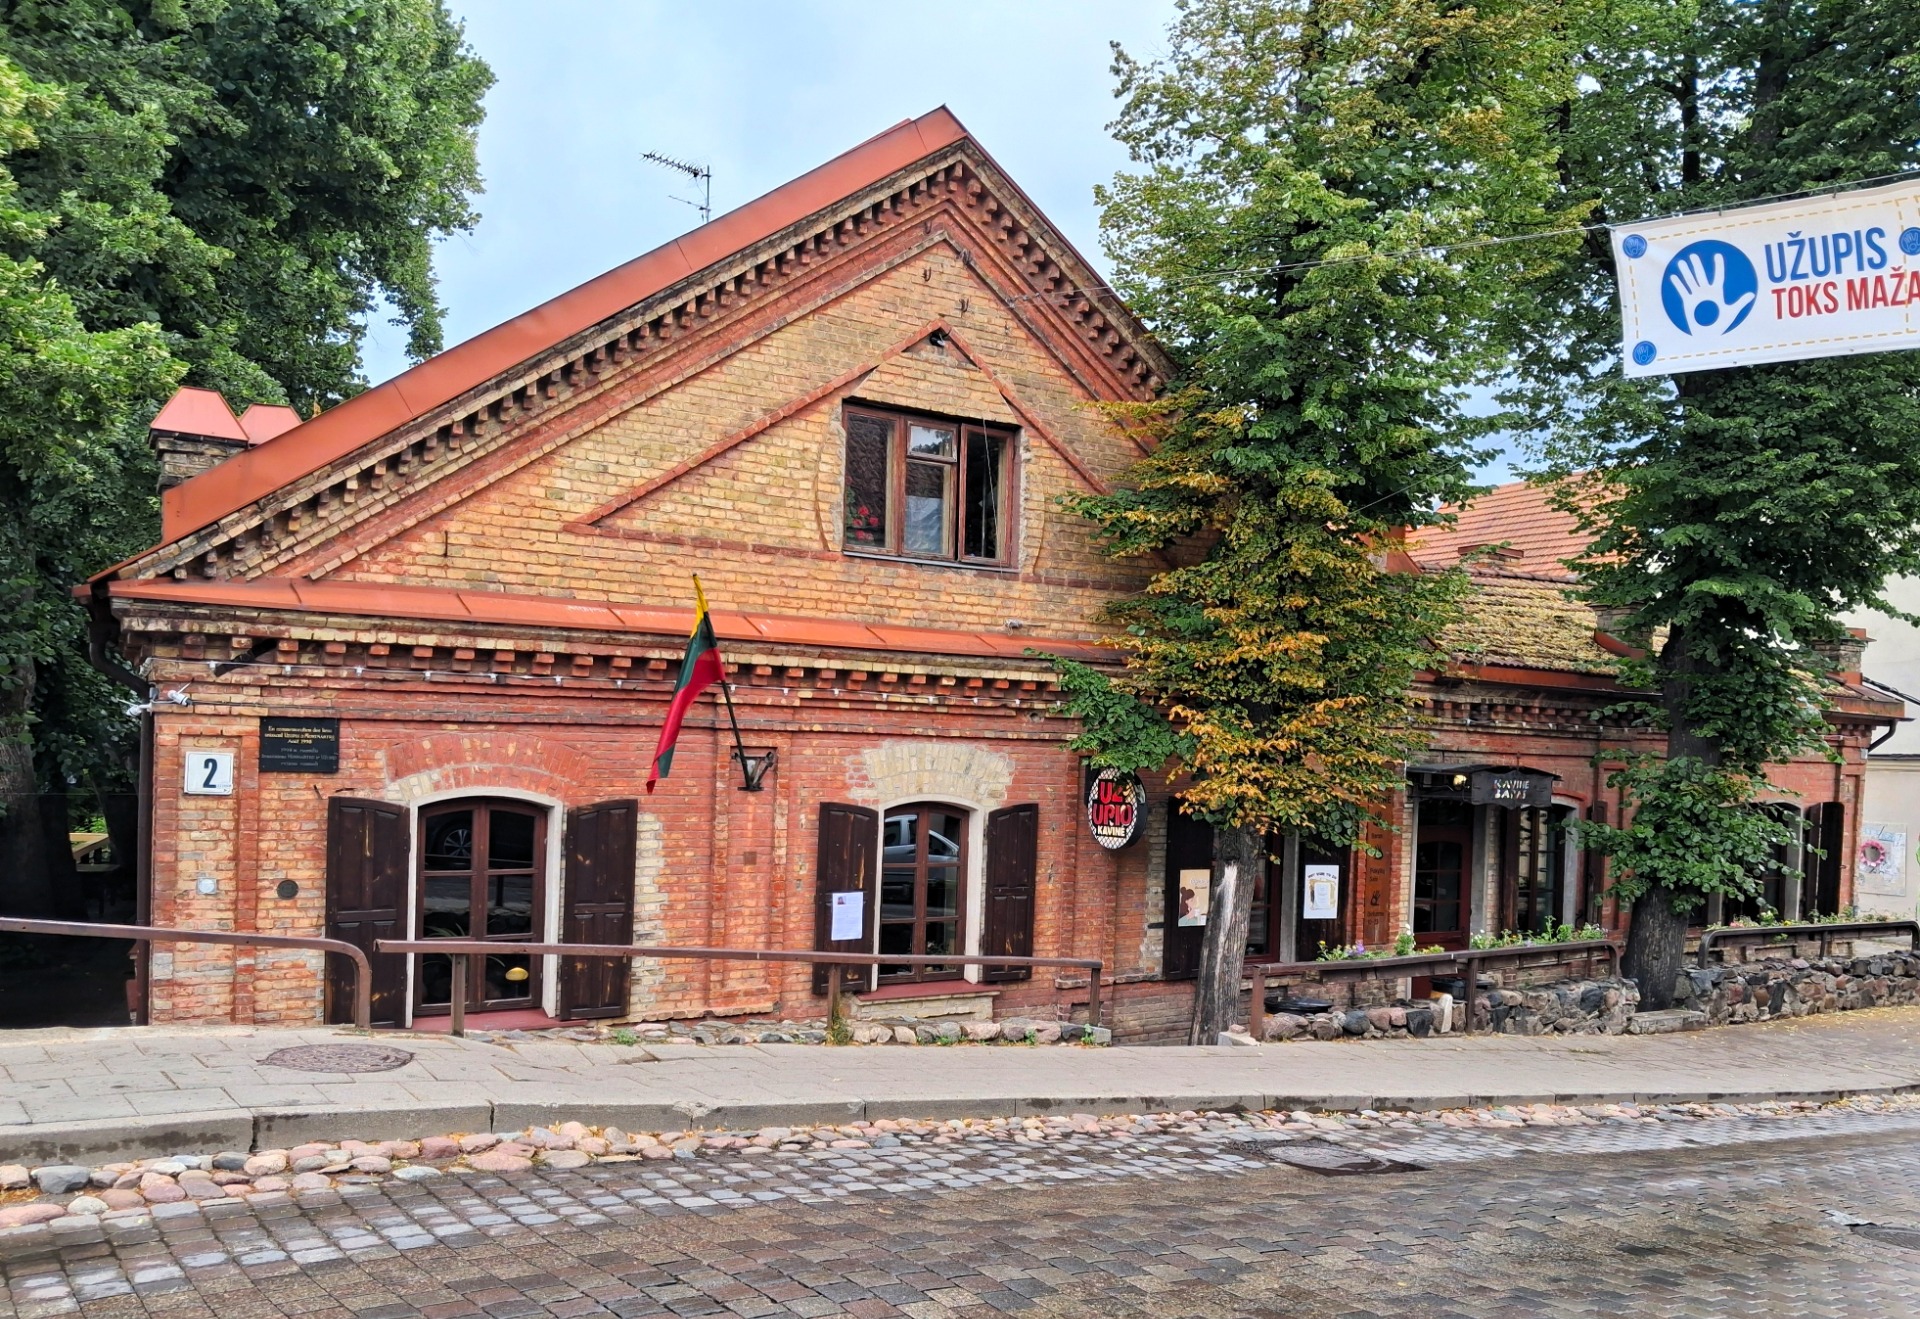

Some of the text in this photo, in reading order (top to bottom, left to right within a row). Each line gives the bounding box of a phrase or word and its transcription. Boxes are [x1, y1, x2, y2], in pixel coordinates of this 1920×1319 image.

[1764, 227, 1888, 284] UŽUPIS
[1771, 265, 1920, 320] TOKS MAŽA
[203, 758, 217, 788] 2
[1092, 803, 1133, 826] UPIO
